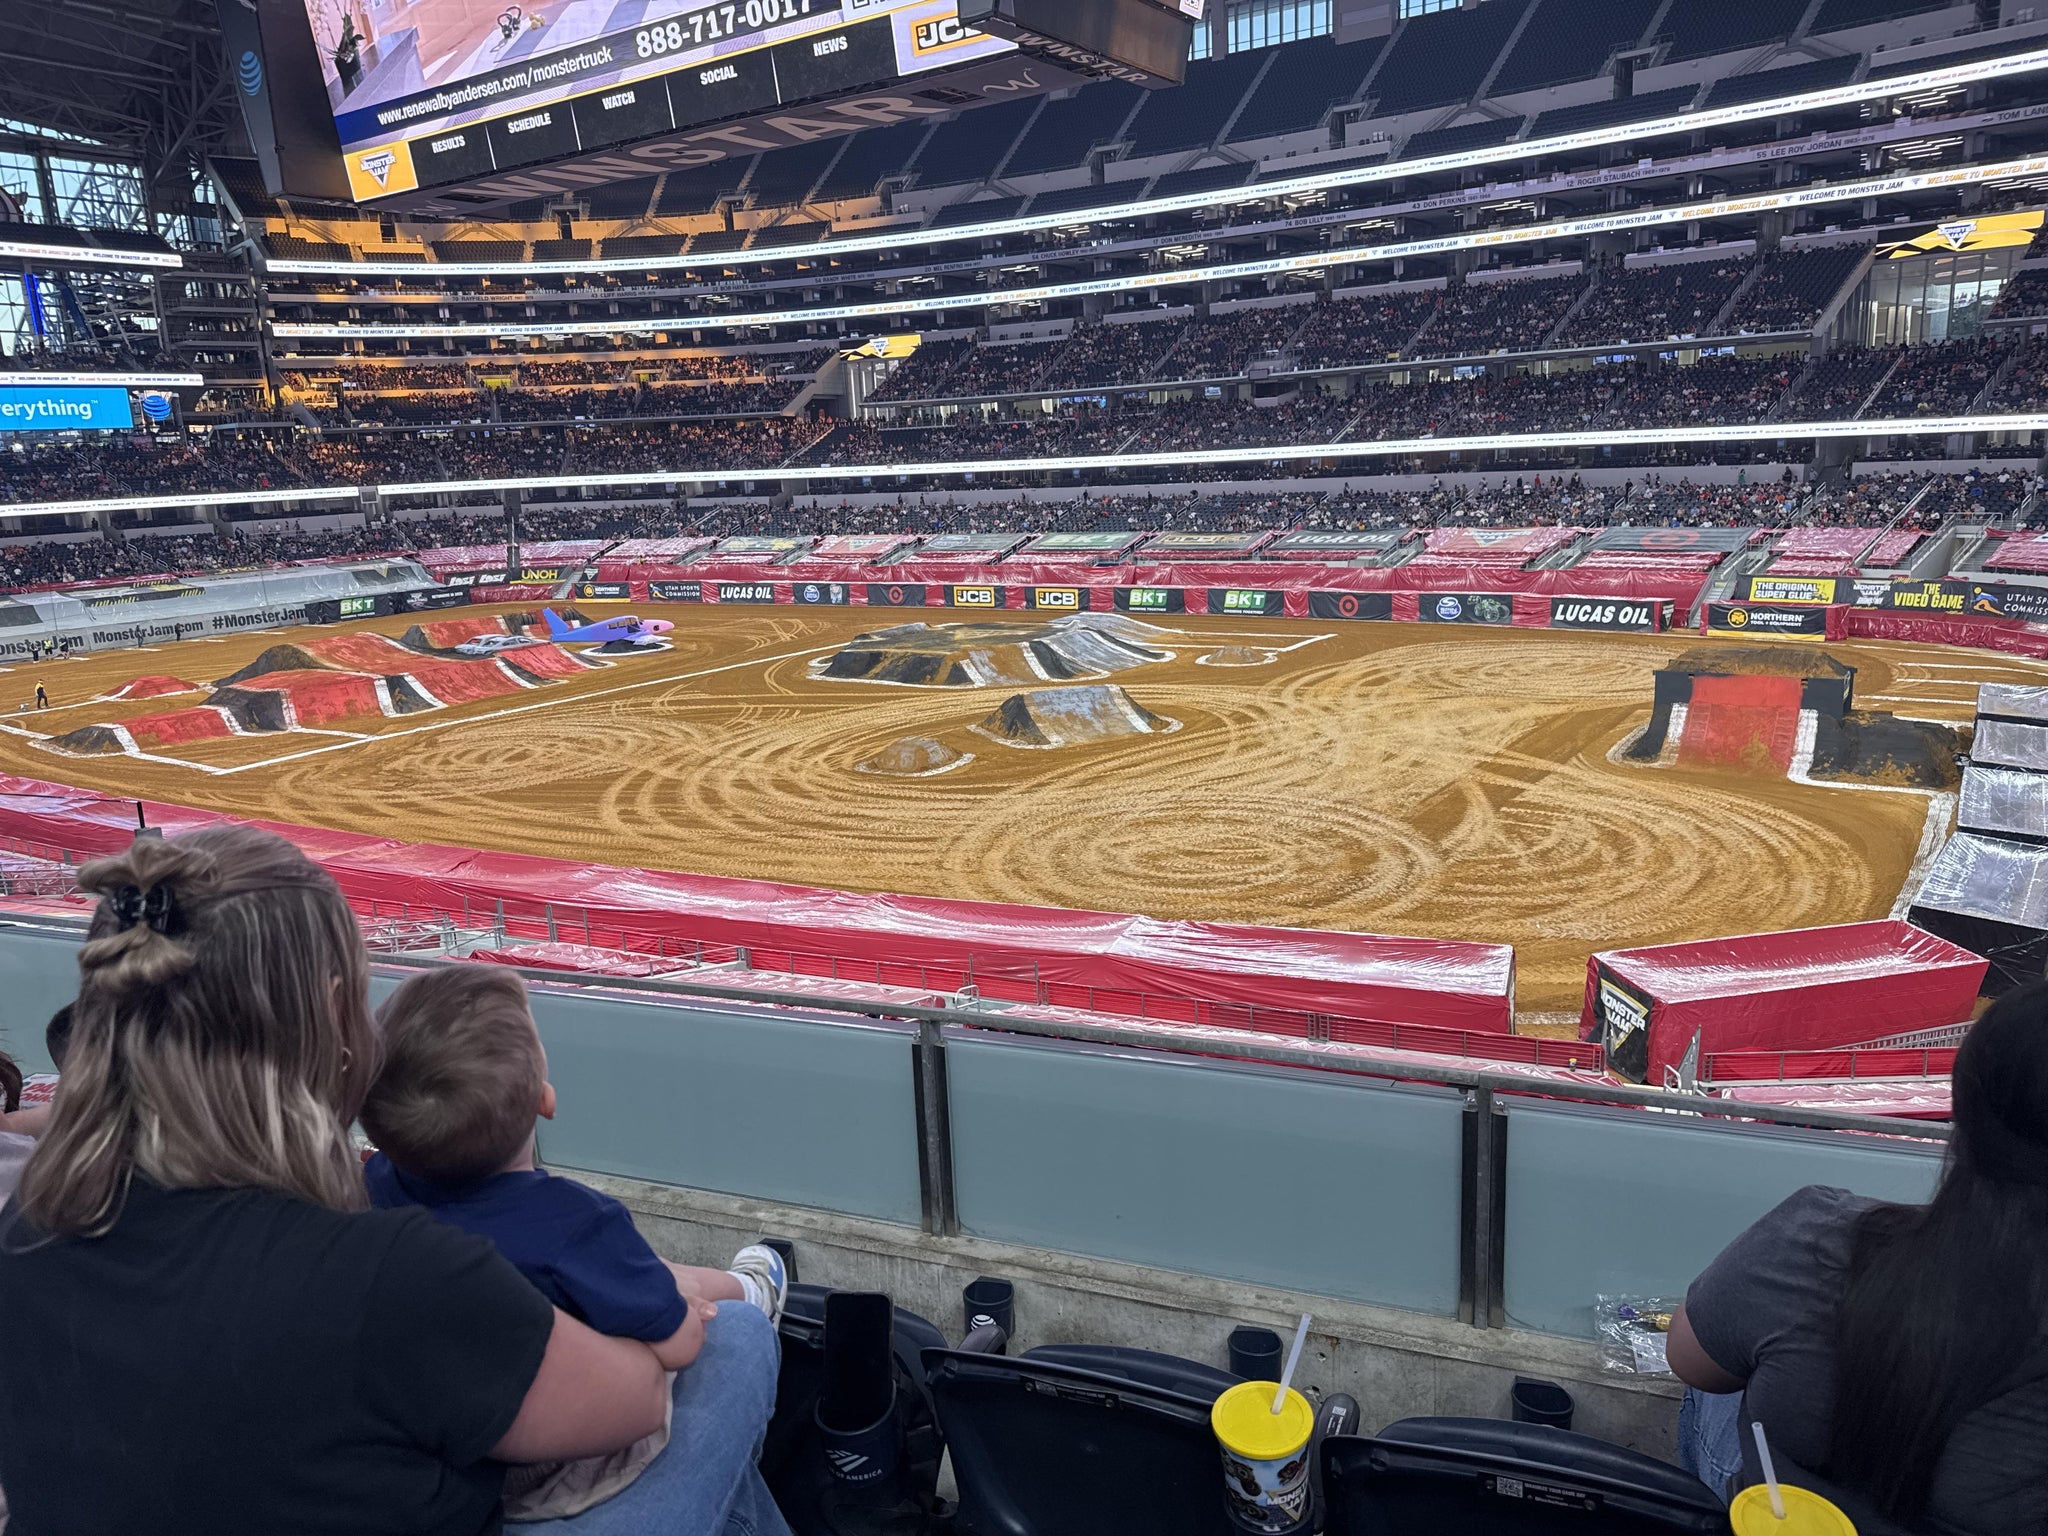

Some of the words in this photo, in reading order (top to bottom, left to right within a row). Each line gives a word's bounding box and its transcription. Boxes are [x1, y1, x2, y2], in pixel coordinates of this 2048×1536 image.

[813, 36, 848, 57] NEWS
[1013, 32, 1149, 83] WINSTAR
[700, 65, 738, 85] SOCIAL
[377, 45, 612, 125] www.renewalbyandersen.com/monstertruck
[602, 91, 636, 111] WATCH
[508, 112, 552, 134] SCHEDULE
[1998, 110, 2021, 121] TOM
[432, 135, 465, 153] RESULTS
[448, 97, 951, 200] WINSTAR
[1757, 151, 1767, 159] 55
[1771, 148, 1786, 157] LEE
[1788, 146, 1806, 154] ROY
[1807, 140, 1842, 151] JORDAN
[361, 154, 396, 172] MONSTER
[370, 166, 389, 177] JAM
[1577, 177, 1602, 187] ROGER
[1604, 172, 1640, 182] STAUBACH
[1928, 171, 1969, 185] WELCOME
[1983, 164, 2024, 178] MONSTER
[2026, 161, 2046, 172] JAM
[1800, 189, 1836, 202] WELCOME
[1837, 188, 1847, 197] TO
[1848, 183, 1884, 196] MONSTER
[1886, 181, 1903, 191] JAM
[1423, 200, 1437, 208] DON
[1439, 196, 1466, 206] PERKINS
[1682, 205, 1716, 217] WELCOME
[1728, 200, 1761, 212] MONSTER
[1763, 198, 1779, 208] JAM
[1295, 218, 1307, 226] BOB
[1309, 216, 1325, 224] LILLY
[1574, 221, 1605, 232] WELCOME
[1606, 220, 1614, 228] TO
[1616, 215, 1646, 227] MONSTER
[1647, 213, 1662, 223] JAM
[1161, 236, 1173, 244] DON
[1174, 232, 1202, 243] MEREDITH
[1383, 245, 1409, 254] WELCOME
[1418, 241, 1444, 251] MONSTER
[1445, 240, 1458, 248] JAM
[1212, 267, 1236, 276] WELCOME
[1244, 264, 1268, 272] MONSTER
[1059, 285, 1081, 294] WELCOME
[1088, 282, 1109, 291] MONSTER
[0, 400, 99, 420] erything™
[1287, 534, 1354, 545] LUCAS
[1362, 533, 1396, 543] OIL
[521, 569, 558, 580] UNOH
[720, 587, 754, 599] LUCAS
[1755, 590, 1787, 599] SUPER
[1788, 591, 1813, 600] GLUE
[1757, 582, 1775, 590] THE
[1775, 582, 1818, 592] ORIGINAL
[1923, 583, 1941, 595] THE
[957, 590, 991, 603] JCB
[1039, 592, 1075, 606] JCB
[1129, 588, 1167, 604] BKT
[1224, 590, 1266, 607] BKT
[1894, 592, 1929, 607] VIDEO
[1931, 594, 1964, 610] GAME
[2006, 593, 2033, 604] UTAH
[340, 598, 374, 615] BKT
[1555, 604, 1614, 623] LUCAS
[0, 634, 84, 654] onsterJm
[93, 620, 204, 645] MonstrJamcom
[212, 608, 307, 630] #MonsterJam
[1607, 1012, 1630, 1034] JAM
[846, 1468, 883, 1480] AMERICA
